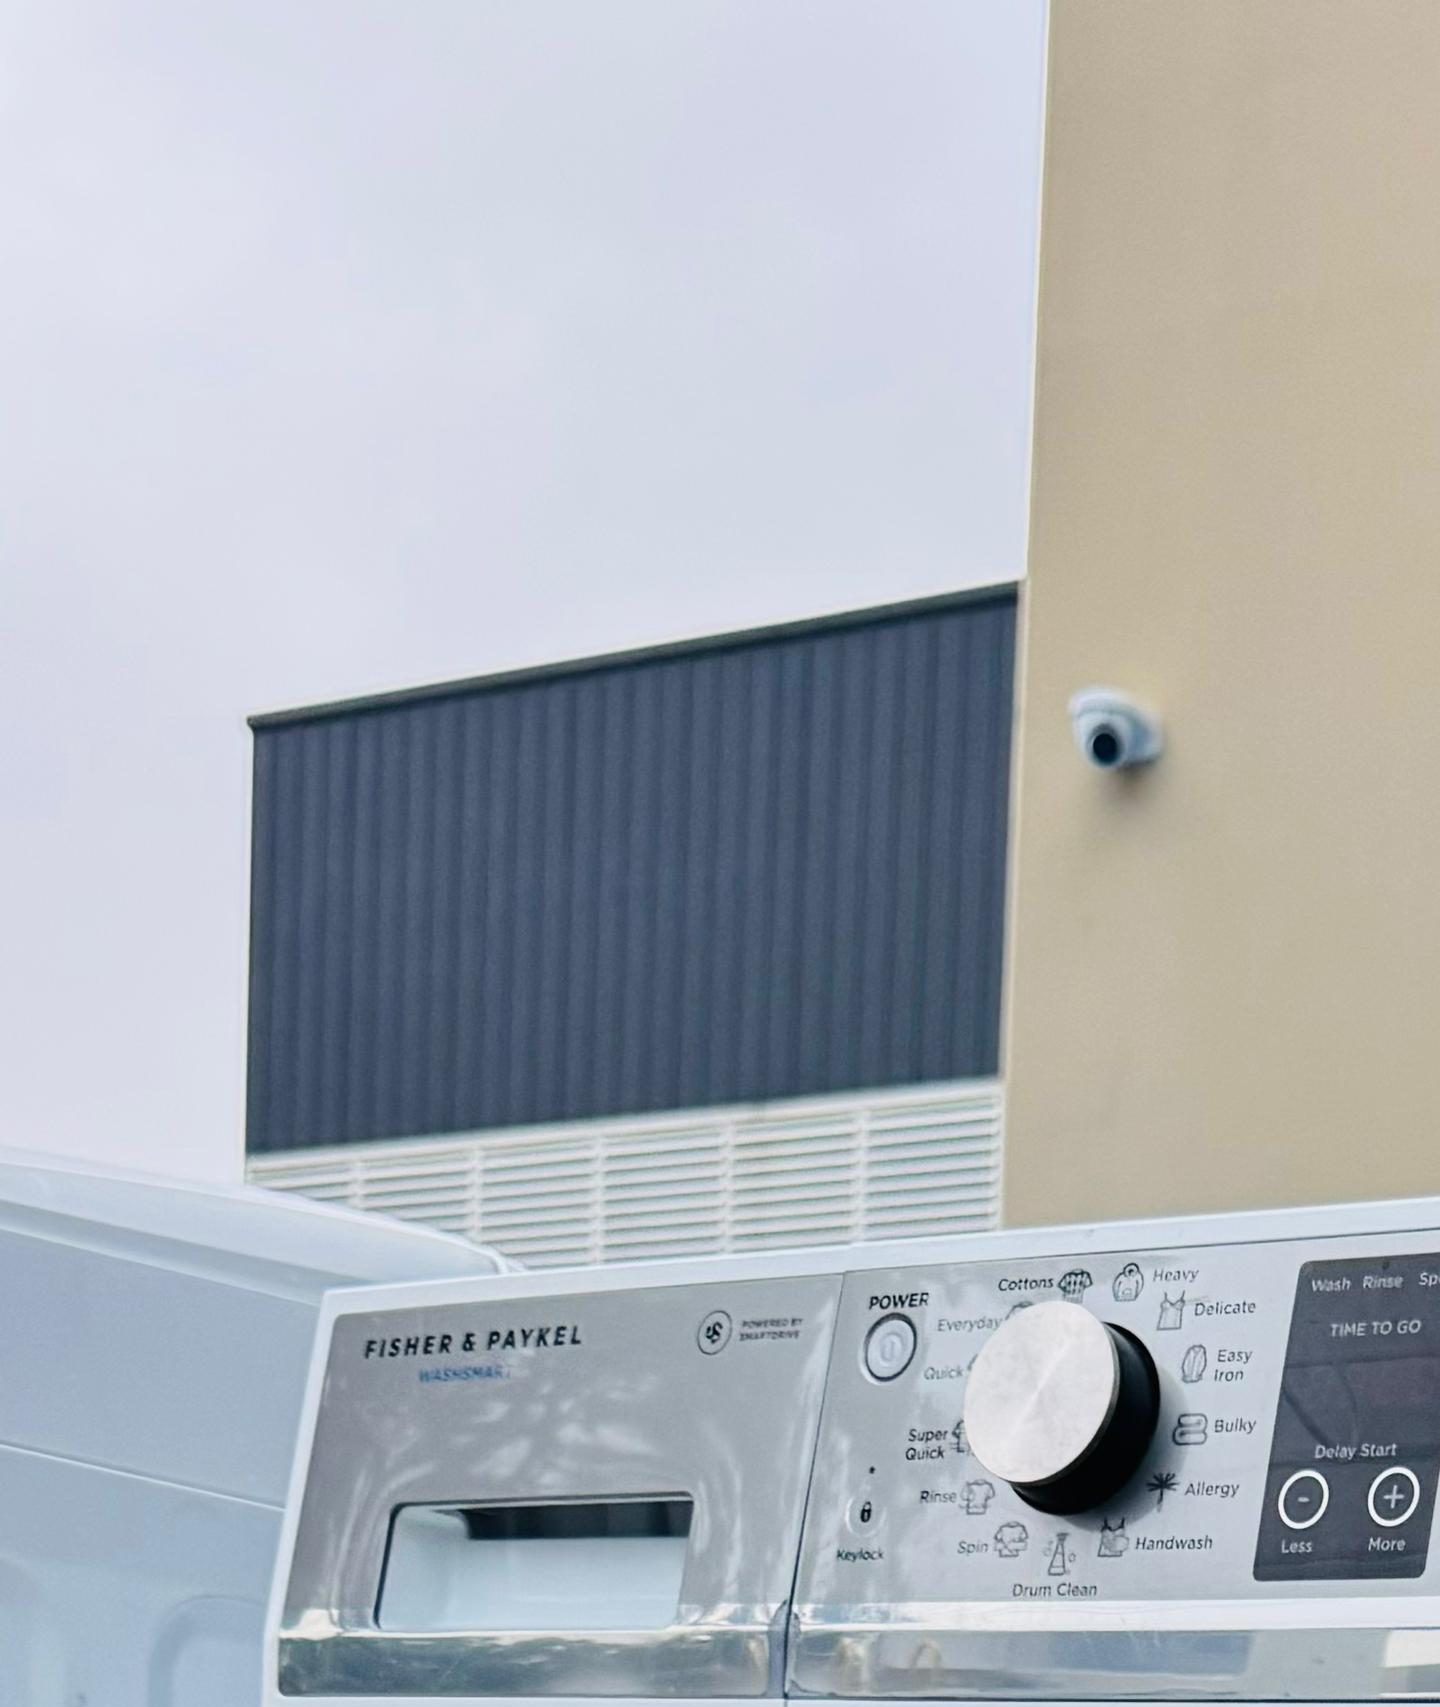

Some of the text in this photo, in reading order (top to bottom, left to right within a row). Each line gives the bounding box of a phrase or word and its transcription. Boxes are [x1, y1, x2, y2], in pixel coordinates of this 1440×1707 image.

[998, 1276, 1055, 1292] Cottons
[1153, 1266, 1200, 1286] Heavy
[1311, 1276, 1351, 1293] Wash
[1362, 1273, 1404, 1290] Rinse
[869, 1292, 929, 1310] POWER
[1193, 1299, 1257, 1317] Delicate
[937, 1316, 1003, 1333] Everyday
[1329, 1319, 1422, 1337] TIME TO GO
[365, 1325, 582, 1359] FISHER & PAYKEL
[1217, 1347, 1253, 1367] Easy
[923, 1364, 964, 1382] Quick
[1214, 1367, 1244, 1383] Iron
[1214, 1416, 1257, 1435] Bulky
[908, 1427, 948, 1443] Super
[905, 1446, 945, 1461] Quick
[1314, 1442, 1397, 1461] Delay Start
[920, 1489, 957, 1504] Rinse
[1184, 1479, 1240, 1500] Allergy
[957, 1540, 989, 1556] Spin
[1135, 1534, 1213, 1553] Handwash
[1281, 1538, 1313, 1554] Less
[1368, 1536, 1406, 1552] More
[836, 1547, 884, 1563] Keylock
[1012, 1582, 1098, 1598] Drum Clean
